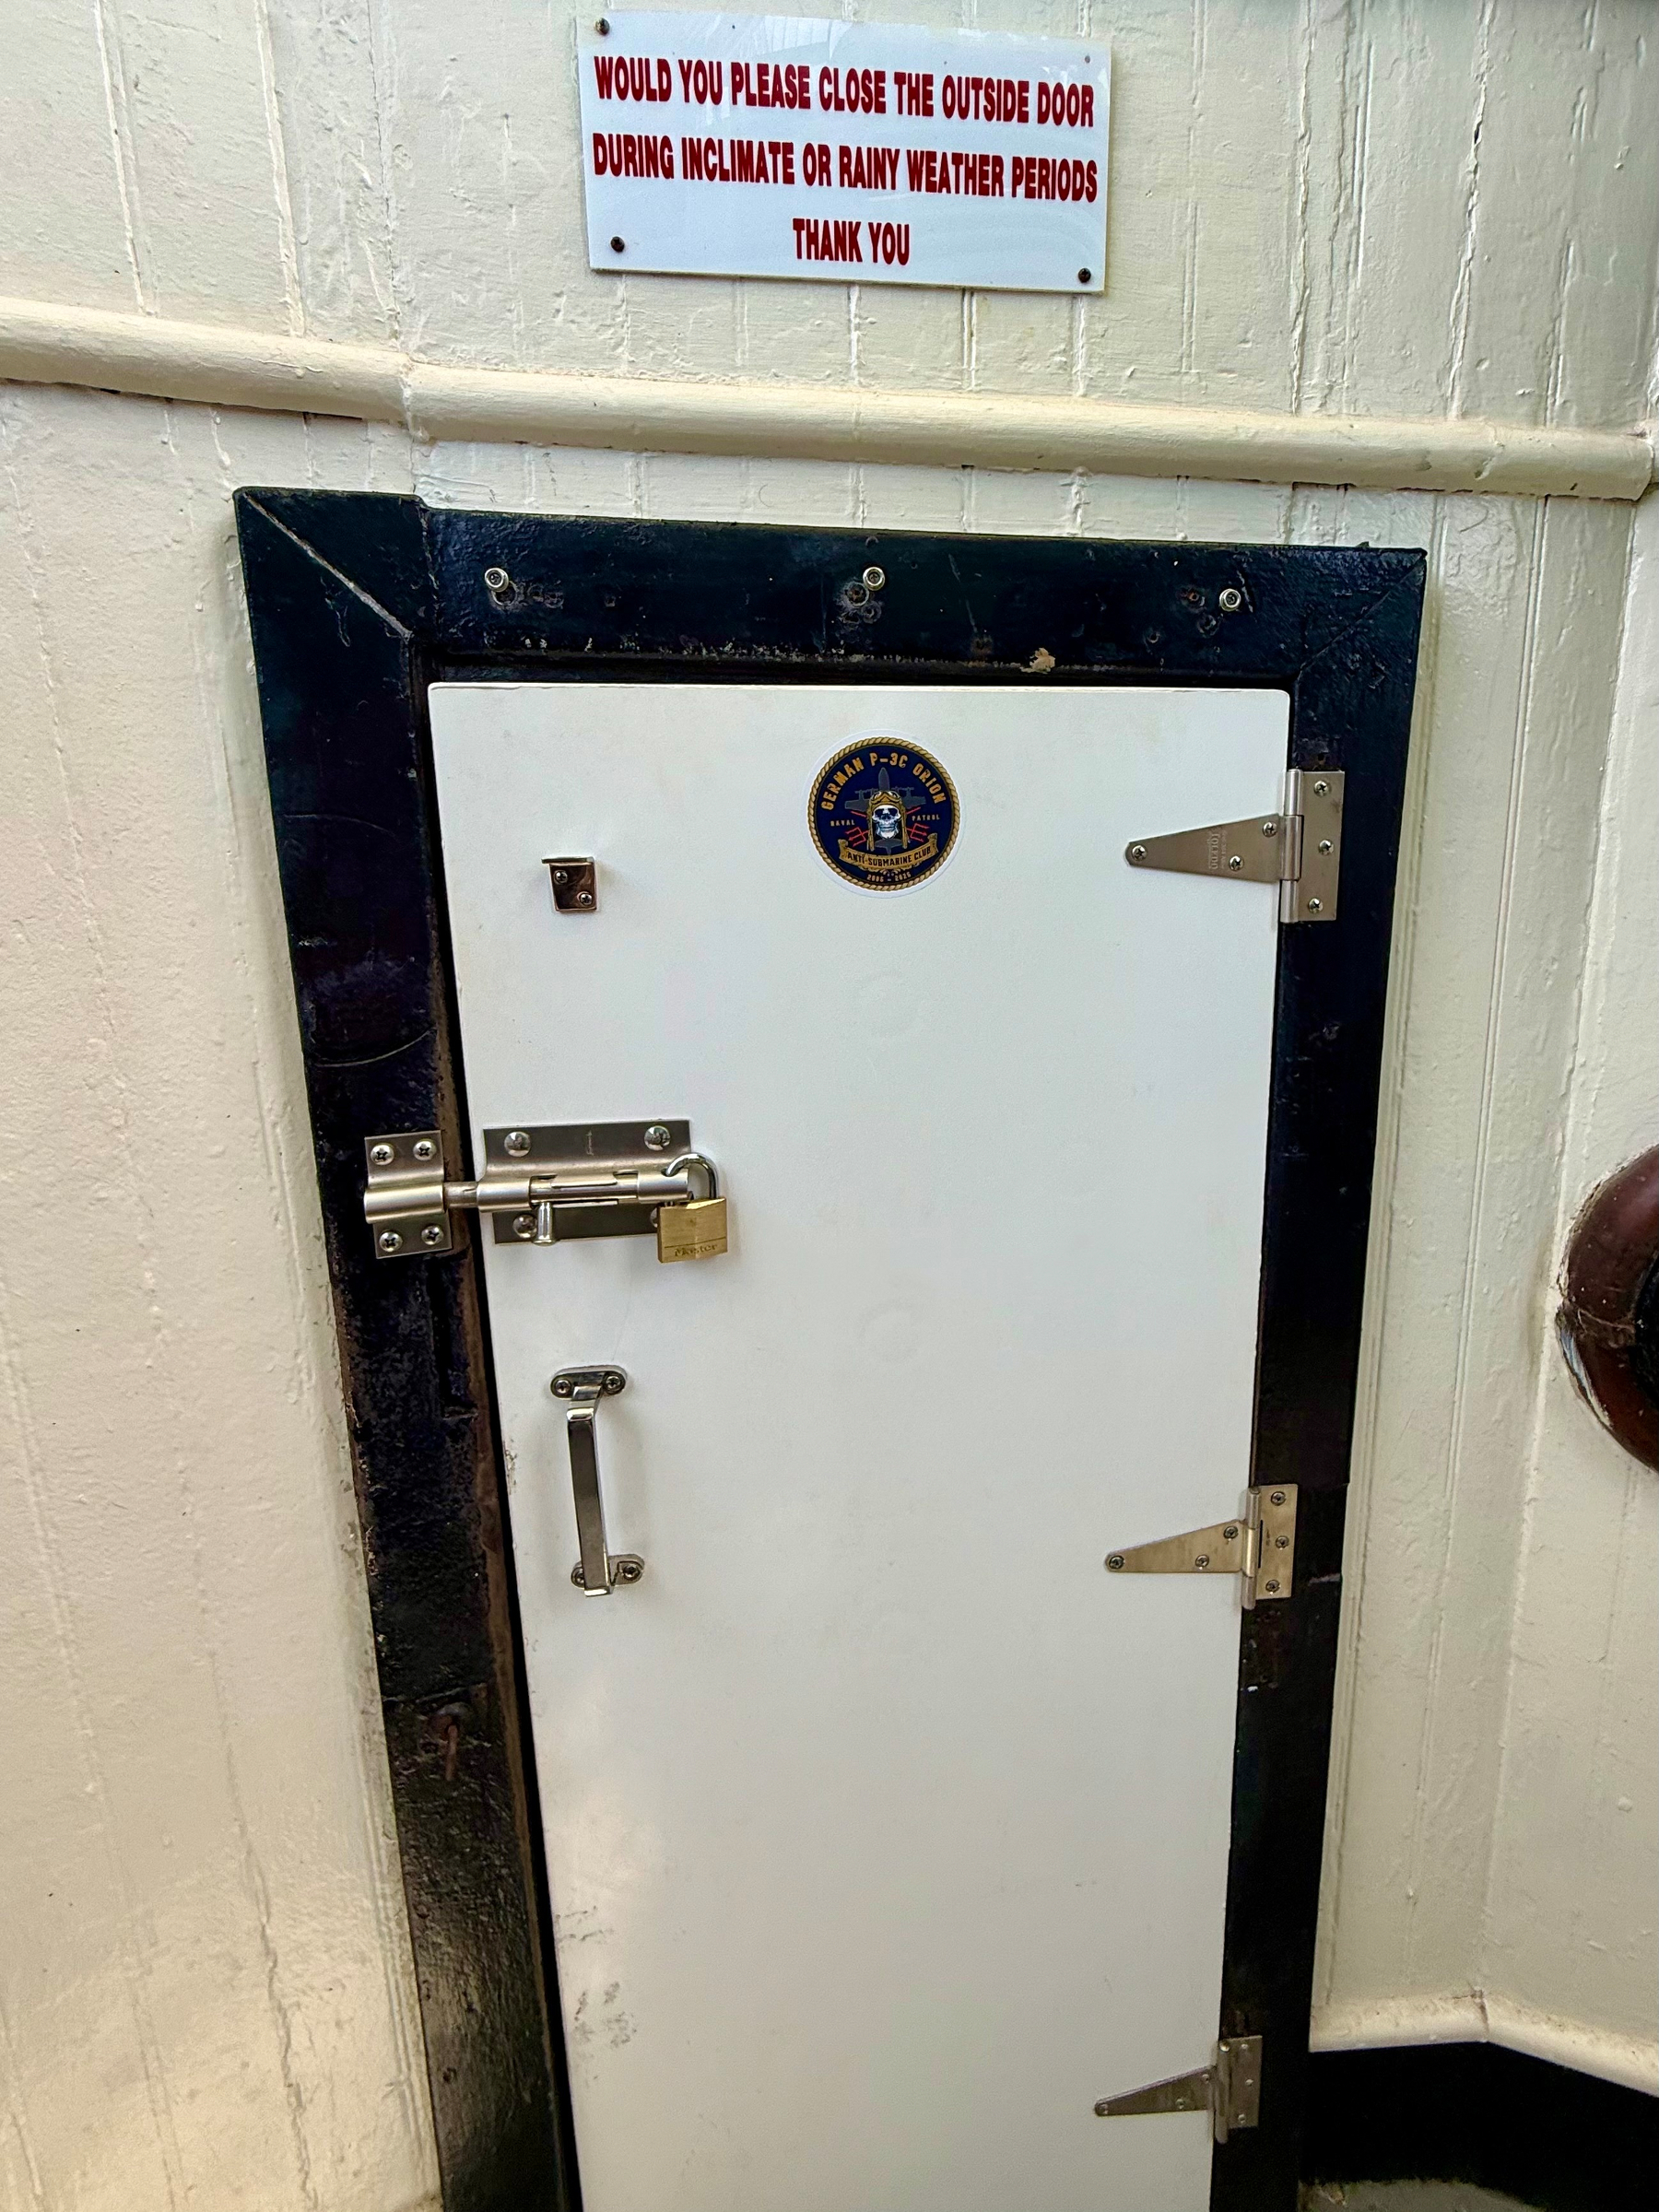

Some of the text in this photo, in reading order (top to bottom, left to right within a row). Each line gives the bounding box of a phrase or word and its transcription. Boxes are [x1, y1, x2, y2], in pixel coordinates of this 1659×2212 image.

[594, 56, 1094, 127] WOULD YOU PLEASE CLOSE THE OUTSIDE DOOR
[593, 133, 1098, 203] DURING INCLIMATE OR RAINY WEATHER PERIODS
[793, 218, 910, 265] THANK YOU
[821, 752, 947, 810] GERMAN P-3C ORION
[847, 846, 931, 866] ANTI-SUBMARINE CLUB
